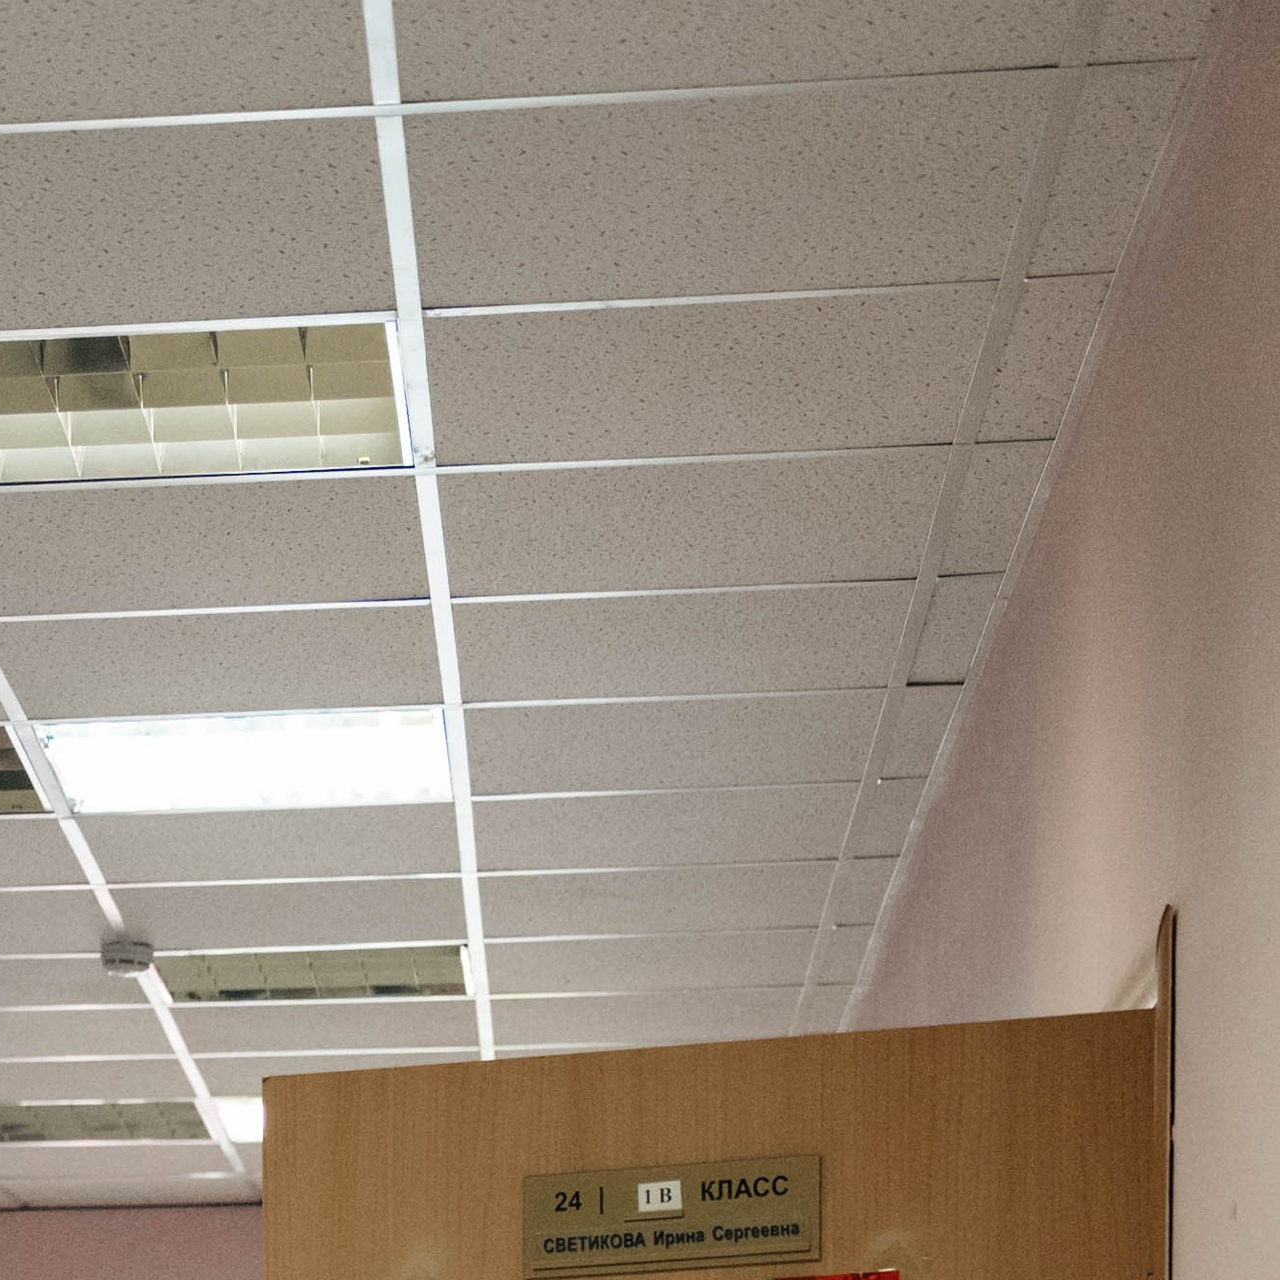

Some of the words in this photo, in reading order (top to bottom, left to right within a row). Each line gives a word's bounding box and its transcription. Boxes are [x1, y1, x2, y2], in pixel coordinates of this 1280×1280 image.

[555, 1191, 582, 1213] 24
[701, 1175, 789, 1202] КЛАСС
[543, 1231, 646, 1254] СВЕТИКОВА
[653, 1229, 705, 1249] Ирина
[712, 1222, 801, 1244] Сергеевна
